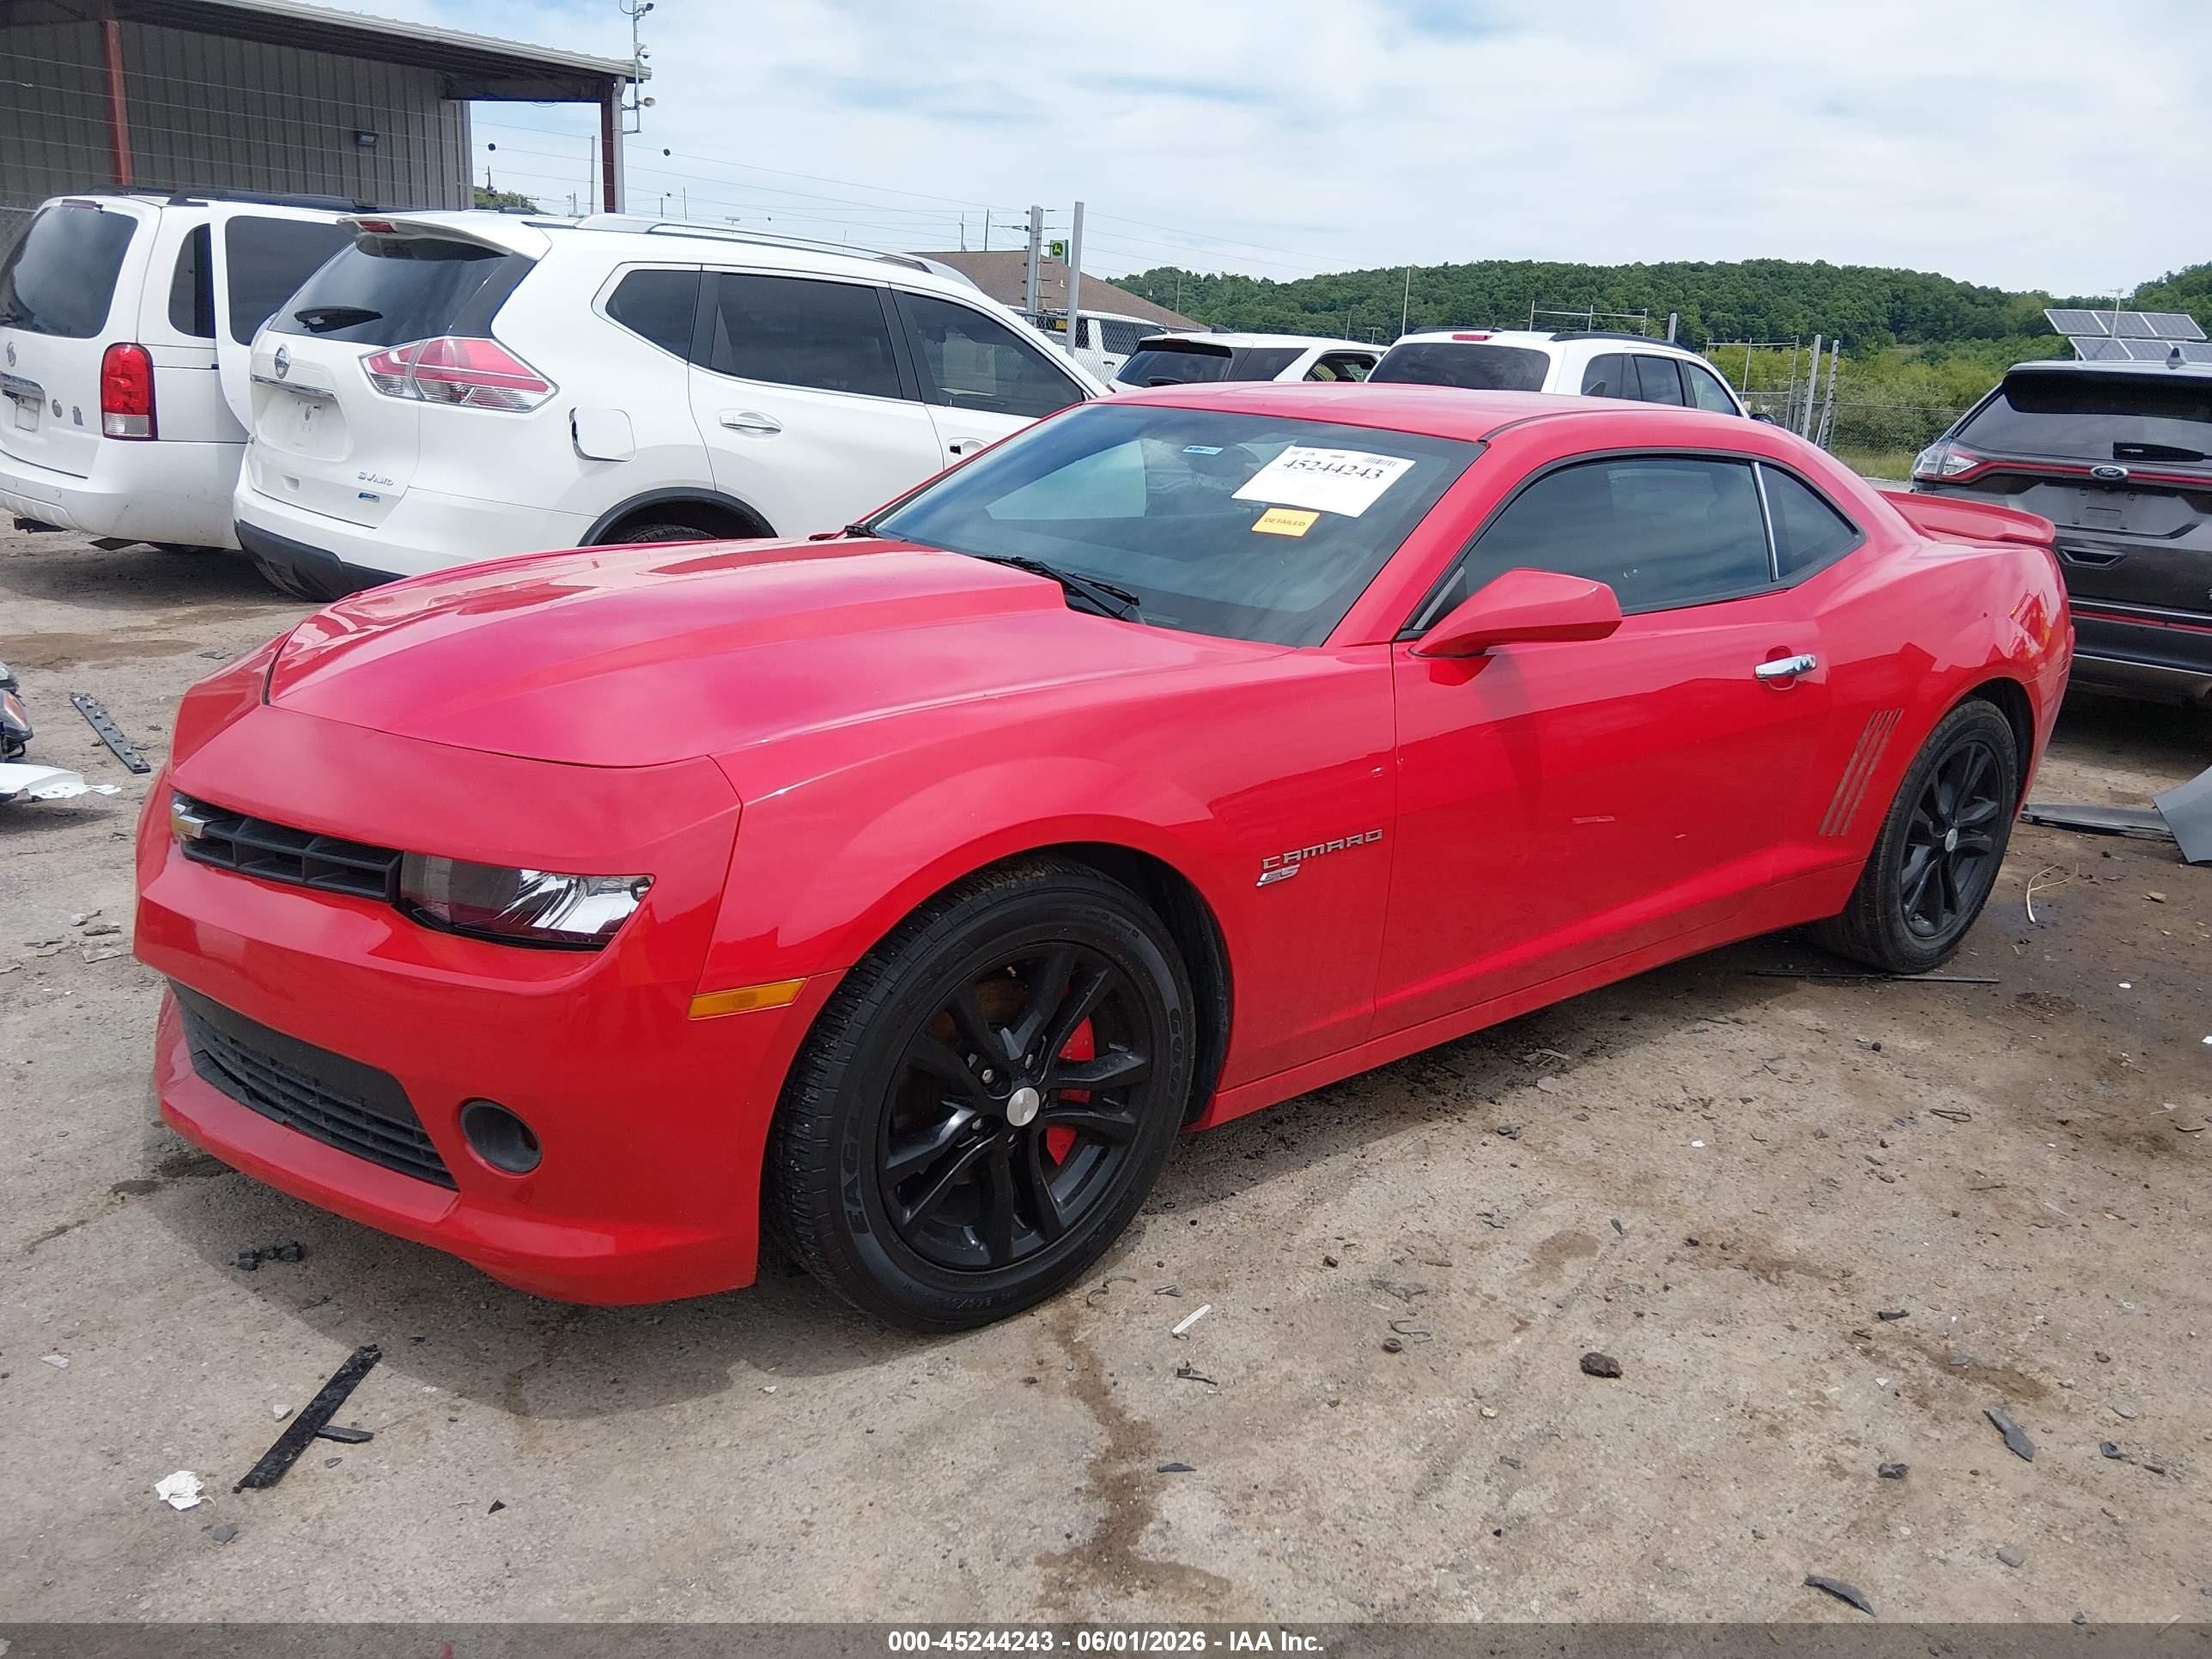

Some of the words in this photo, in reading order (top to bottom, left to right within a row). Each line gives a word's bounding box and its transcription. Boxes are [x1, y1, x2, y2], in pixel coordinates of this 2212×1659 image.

[1282, 459, 1384, 480] 45244243
[1263, 517, 1306, 527] DETAILED
[1262, 829, 1382, 870] CAMARO
